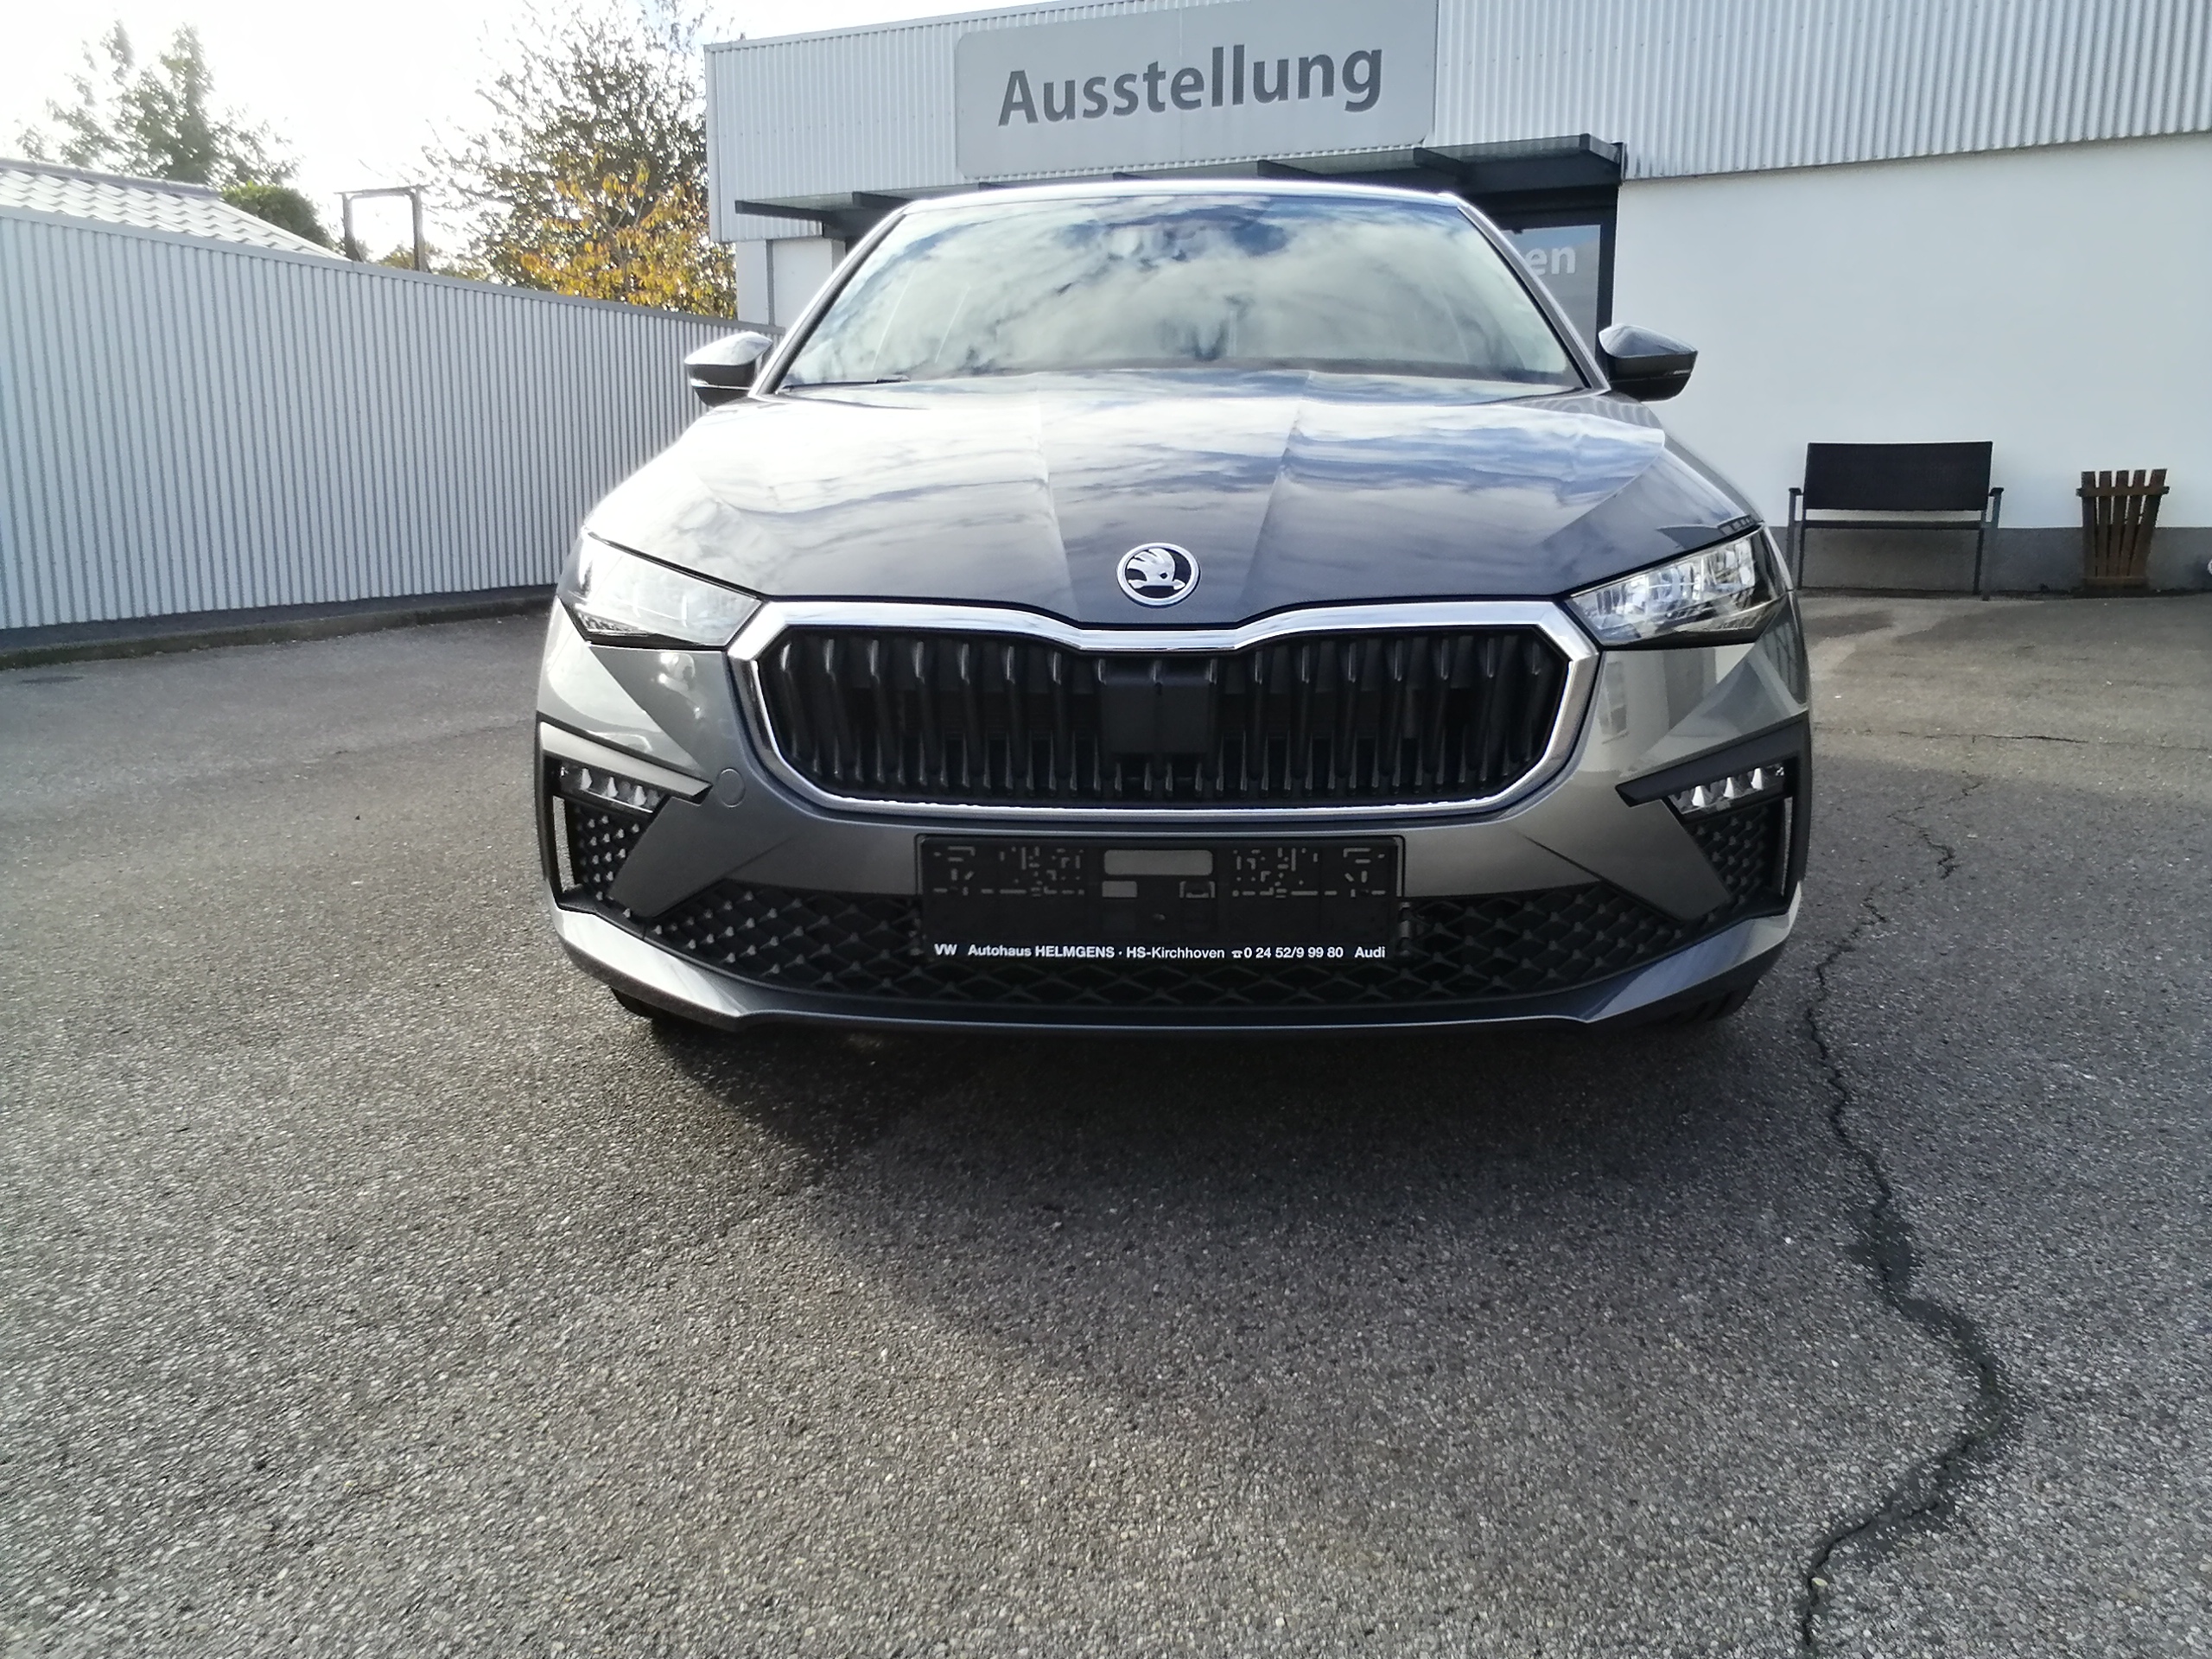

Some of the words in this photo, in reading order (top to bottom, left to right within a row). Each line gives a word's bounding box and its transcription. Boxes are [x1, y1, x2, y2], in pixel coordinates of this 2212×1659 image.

[998, 44, 1382, 127] Ausstellung
[933, 943, 957, 956] VW
[967, 944, 1033, 957] Autohaus
[1034, 944, 1116, 959] HELMGENS
[1126, 946, 1225, 959] HS-Kirchhoven
[1255, 946, 1272, 959] 24
[1274, 946, 1305, 959] 52/9
[1307, 946, 1325, 958] 99
[1326, 946, 1344, 958] 80
[1354, 945, 1386, 958] Audi
